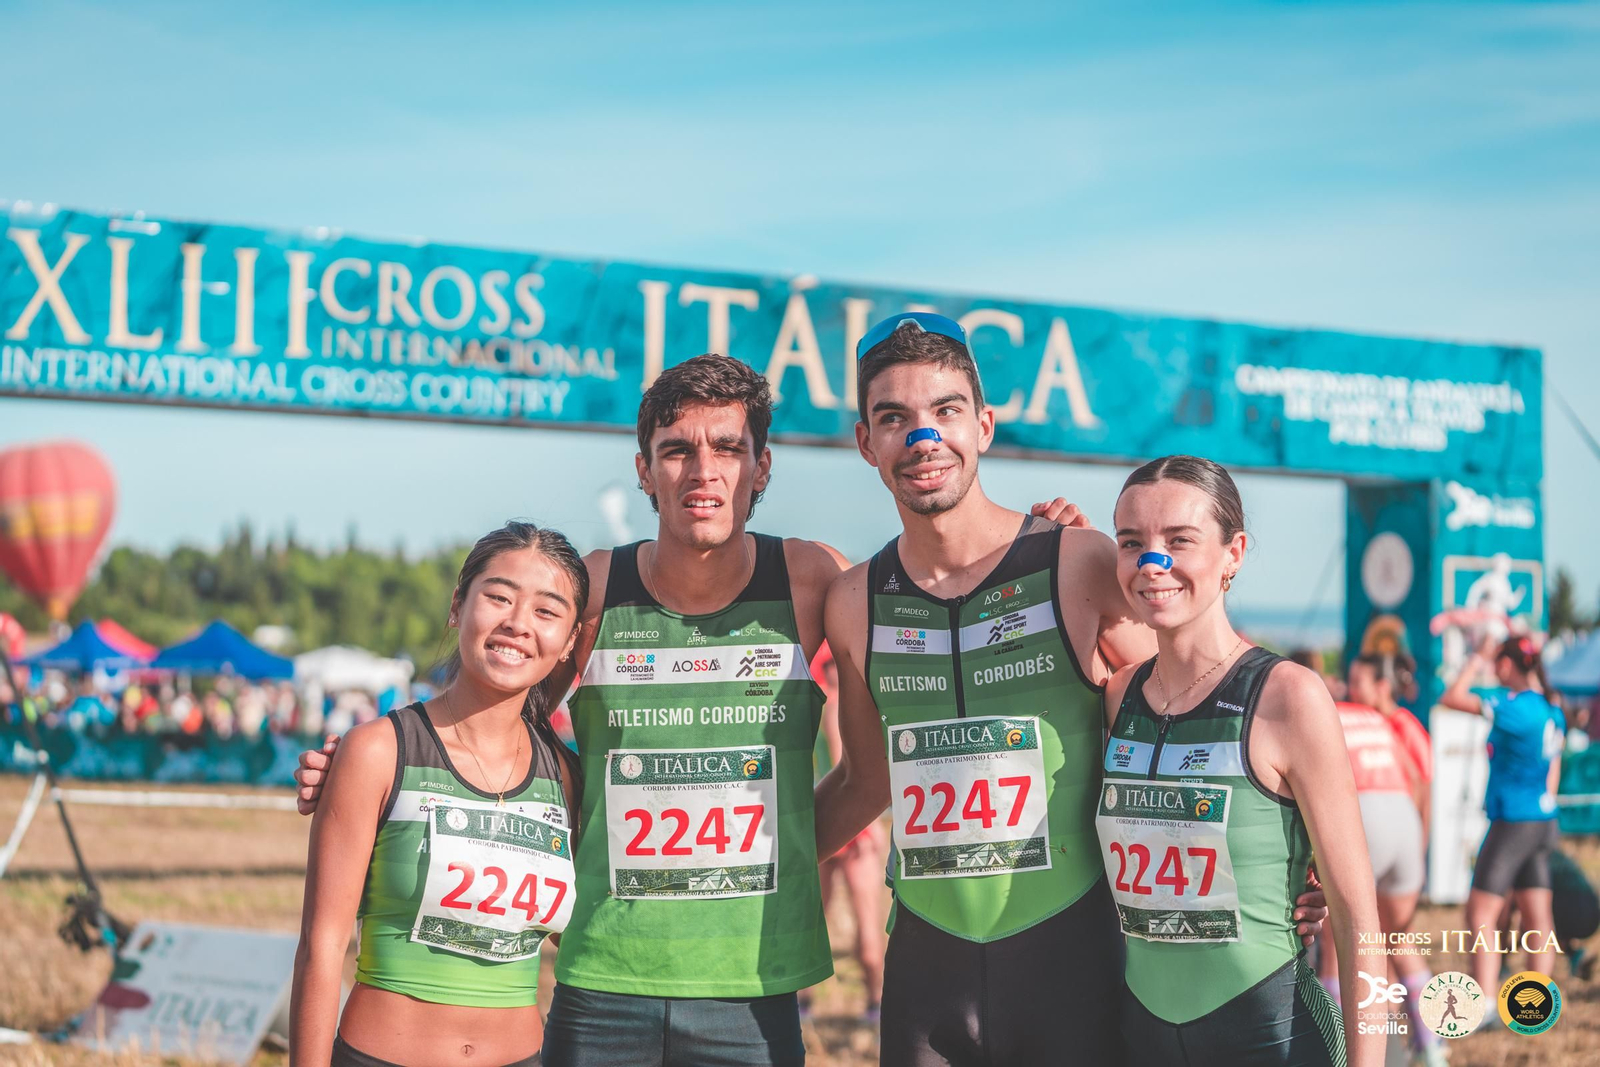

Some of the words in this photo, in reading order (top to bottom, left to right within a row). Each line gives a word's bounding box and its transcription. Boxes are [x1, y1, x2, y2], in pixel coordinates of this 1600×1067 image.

[319, 257, 546, 338] CROSS
[320, 325, 619, 381] INTERNACIONAL
[638, 275, 1100, 428] ITÁLCA
[1, 345, 297, 400] INTERNATIONAL
[301, 364, 408, 406] CROSS
[410, 372, 571, 416] COUNTRY
[985, 584, 1022, 605] AOSSA
[902, 608, 929, 616] IMDECO
[624, 631, 659, 639] IMDECO
[1004, 629, 1024, 640] CAC
[616, 664, 655, 673] CÓRDOBA
[672, 659, 718, 672] AOSSA
[755, 669, 778, 677] CAC
[879, 676, 947, 693] ATLETISMO
[974, 653, 1055, 686] CORDOBÉS
[745, 688, 774, 696] CÓRDOBA
[608, 707, 694, 727] ATLETISMO
[700, 701, 786, 725] CORDOBÉS
[1217, 701, 1245, 713] DECATHLON
[925, 726, 994, 747] ITÁLICA
[654, 754, 731, 774] ITÁLICA
[916, 759, 943, 767] CORDOBA
[945, 756, 986, 764] PATRIMONIO
[428, 781, 454, 791] IMDECO
[904, 776, 1031, 835] 2247
[1125, 787, 1185, 809] ITÁLICA
[480, 813, 543, 841] ITÁLICA
[625, 805, 764, 856] 2247
[1141, 820, 1176, 828] PATRIMONIO
[468, 839, 500, 849] CORDOBA
[501, 845, 537, 857] PATRIMONIO
[1110, 842, 1217, 896] 2247
[440, 861, 567, 924] 2247
